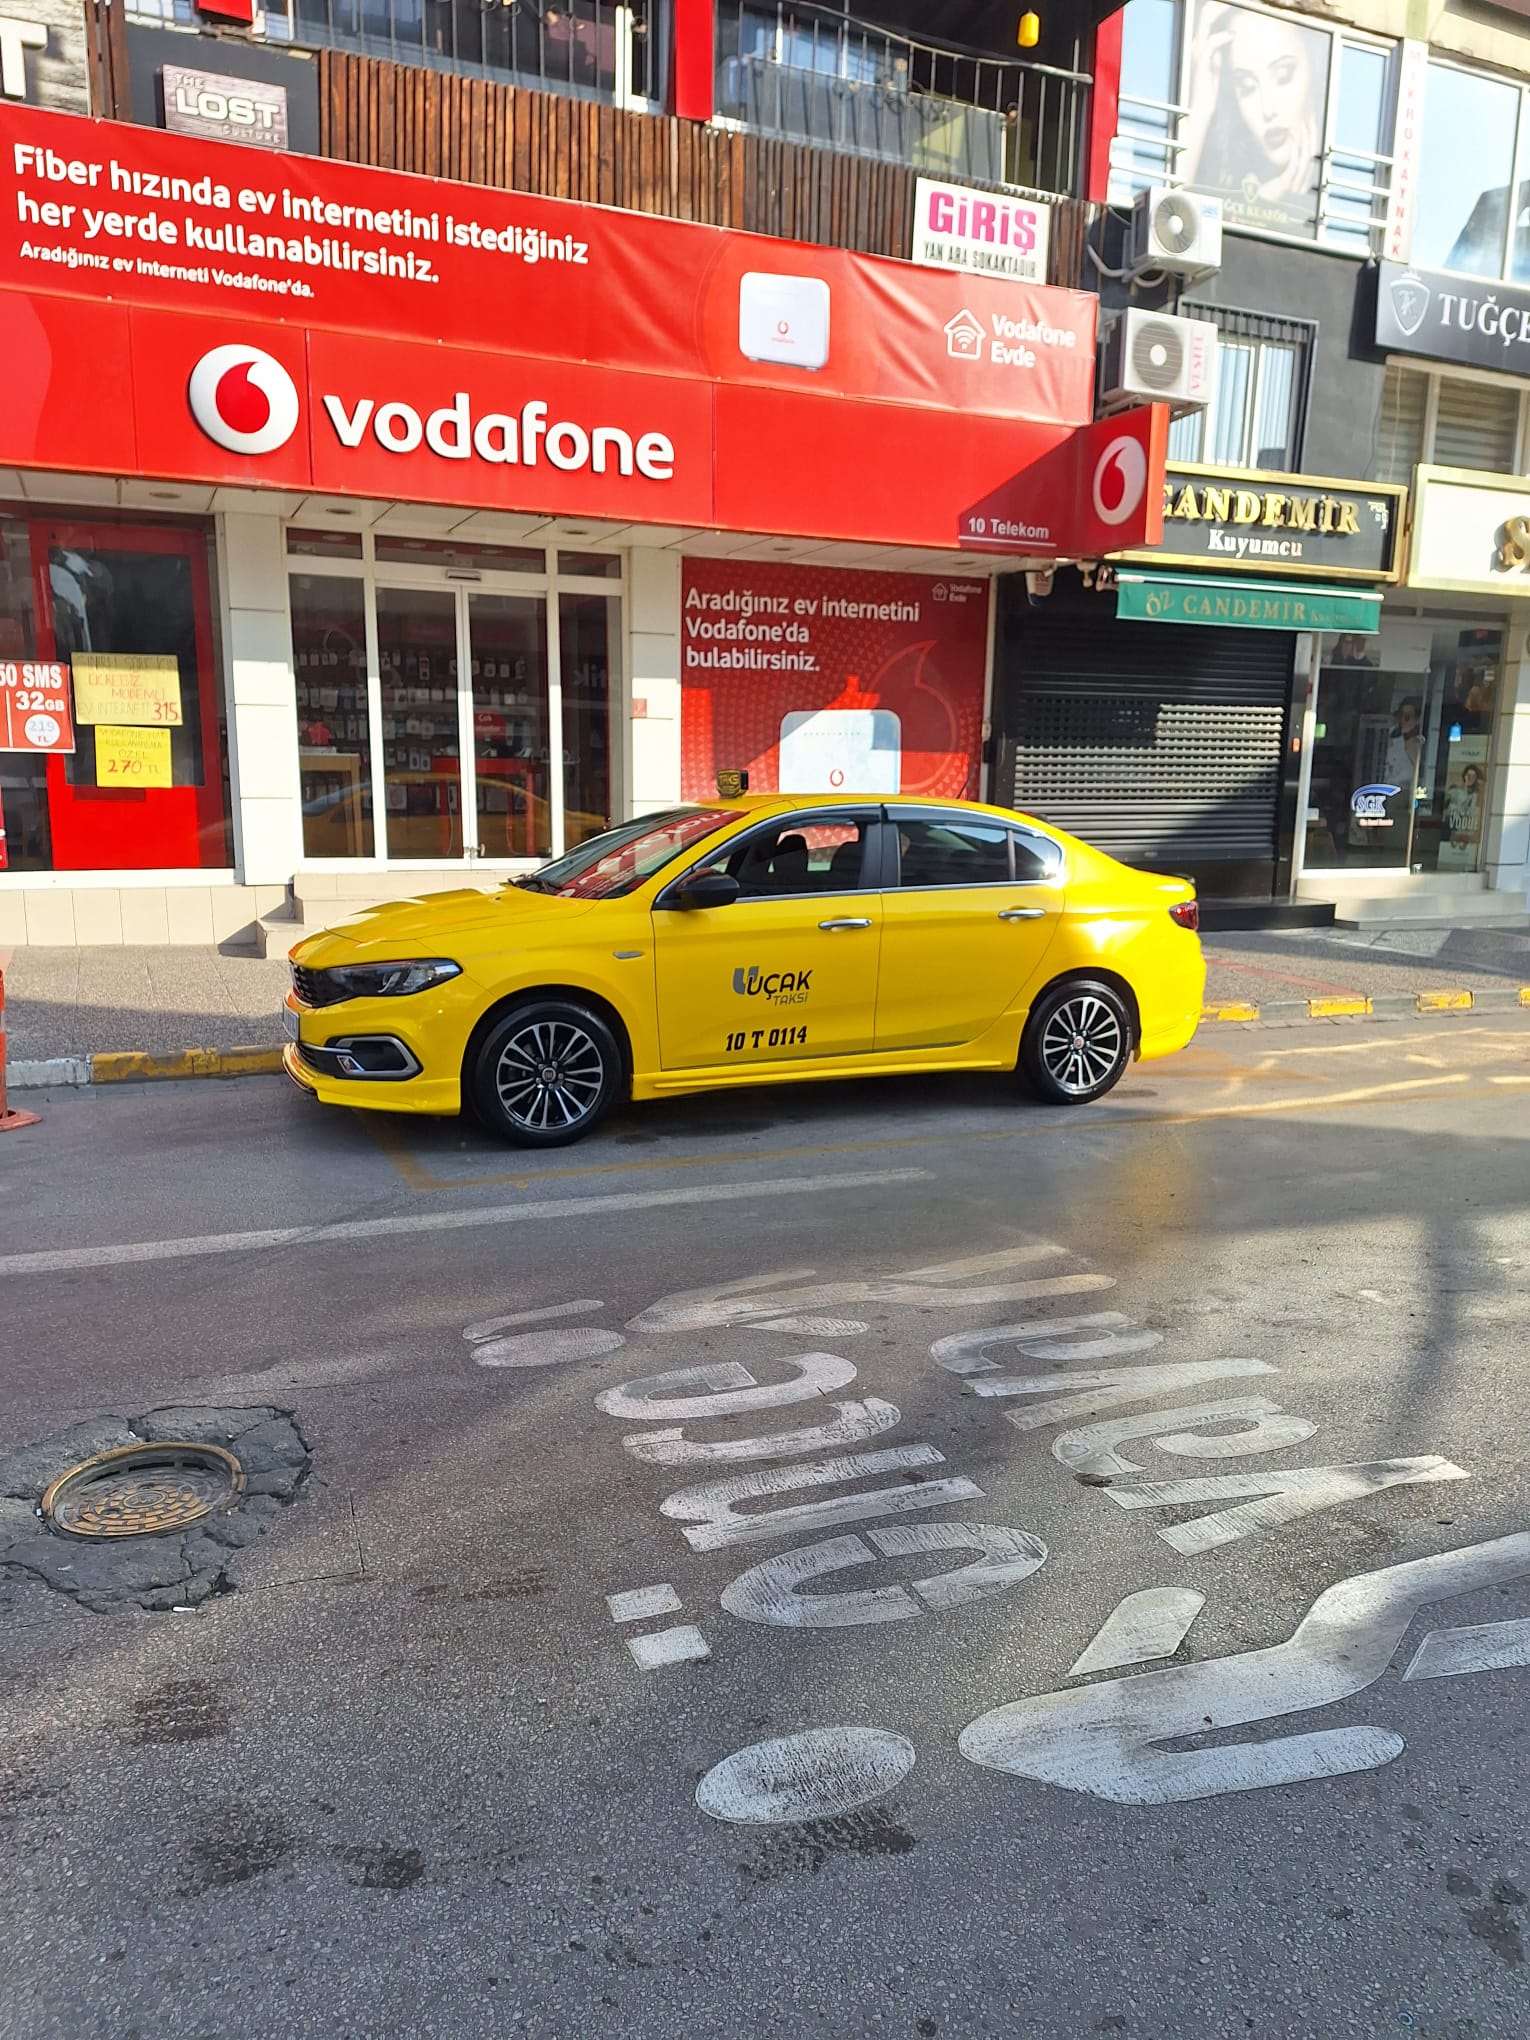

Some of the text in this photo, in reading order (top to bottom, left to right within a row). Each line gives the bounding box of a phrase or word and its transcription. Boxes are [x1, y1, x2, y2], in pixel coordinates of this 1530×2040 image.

[175, 73, 205, 90] THE
[175, 87, 281, 129] LOST
[14, 143, 589, 264] Fiber hızında ev internetini istediğiniz
[17, 190, 440, 284] her yerde kullanabilirsiniz.
[924, 240, 944, 262] YAN
[947, 245, 967, 266] ARA
[20, 241, 110, 268] Aradığınız
[112, 257, 134, 273] ev
[211, 268, 315, 298] Vodafone'da.
[991, 313, 1077, 348] Vodafone
[990, 340, 1036, 368] Evde
[322, 392, 676, 480] vodafone
[968, 517, 1049, 539] 10 Telekom
[1208, 528, 1303, 559] Kuyumcu
[685, 587, 921, 622] Aradığınız ev internetini
[686, 645, 821, 672] bulabilirsiniz.
[23, 664, 63, 689] SMS
[151, 701, 179, 722] 315
[37, 735, 49, 743] TL
[107, 758, 143, 774] 270
[725, 1025, 808, 1052] 10 T 0114
